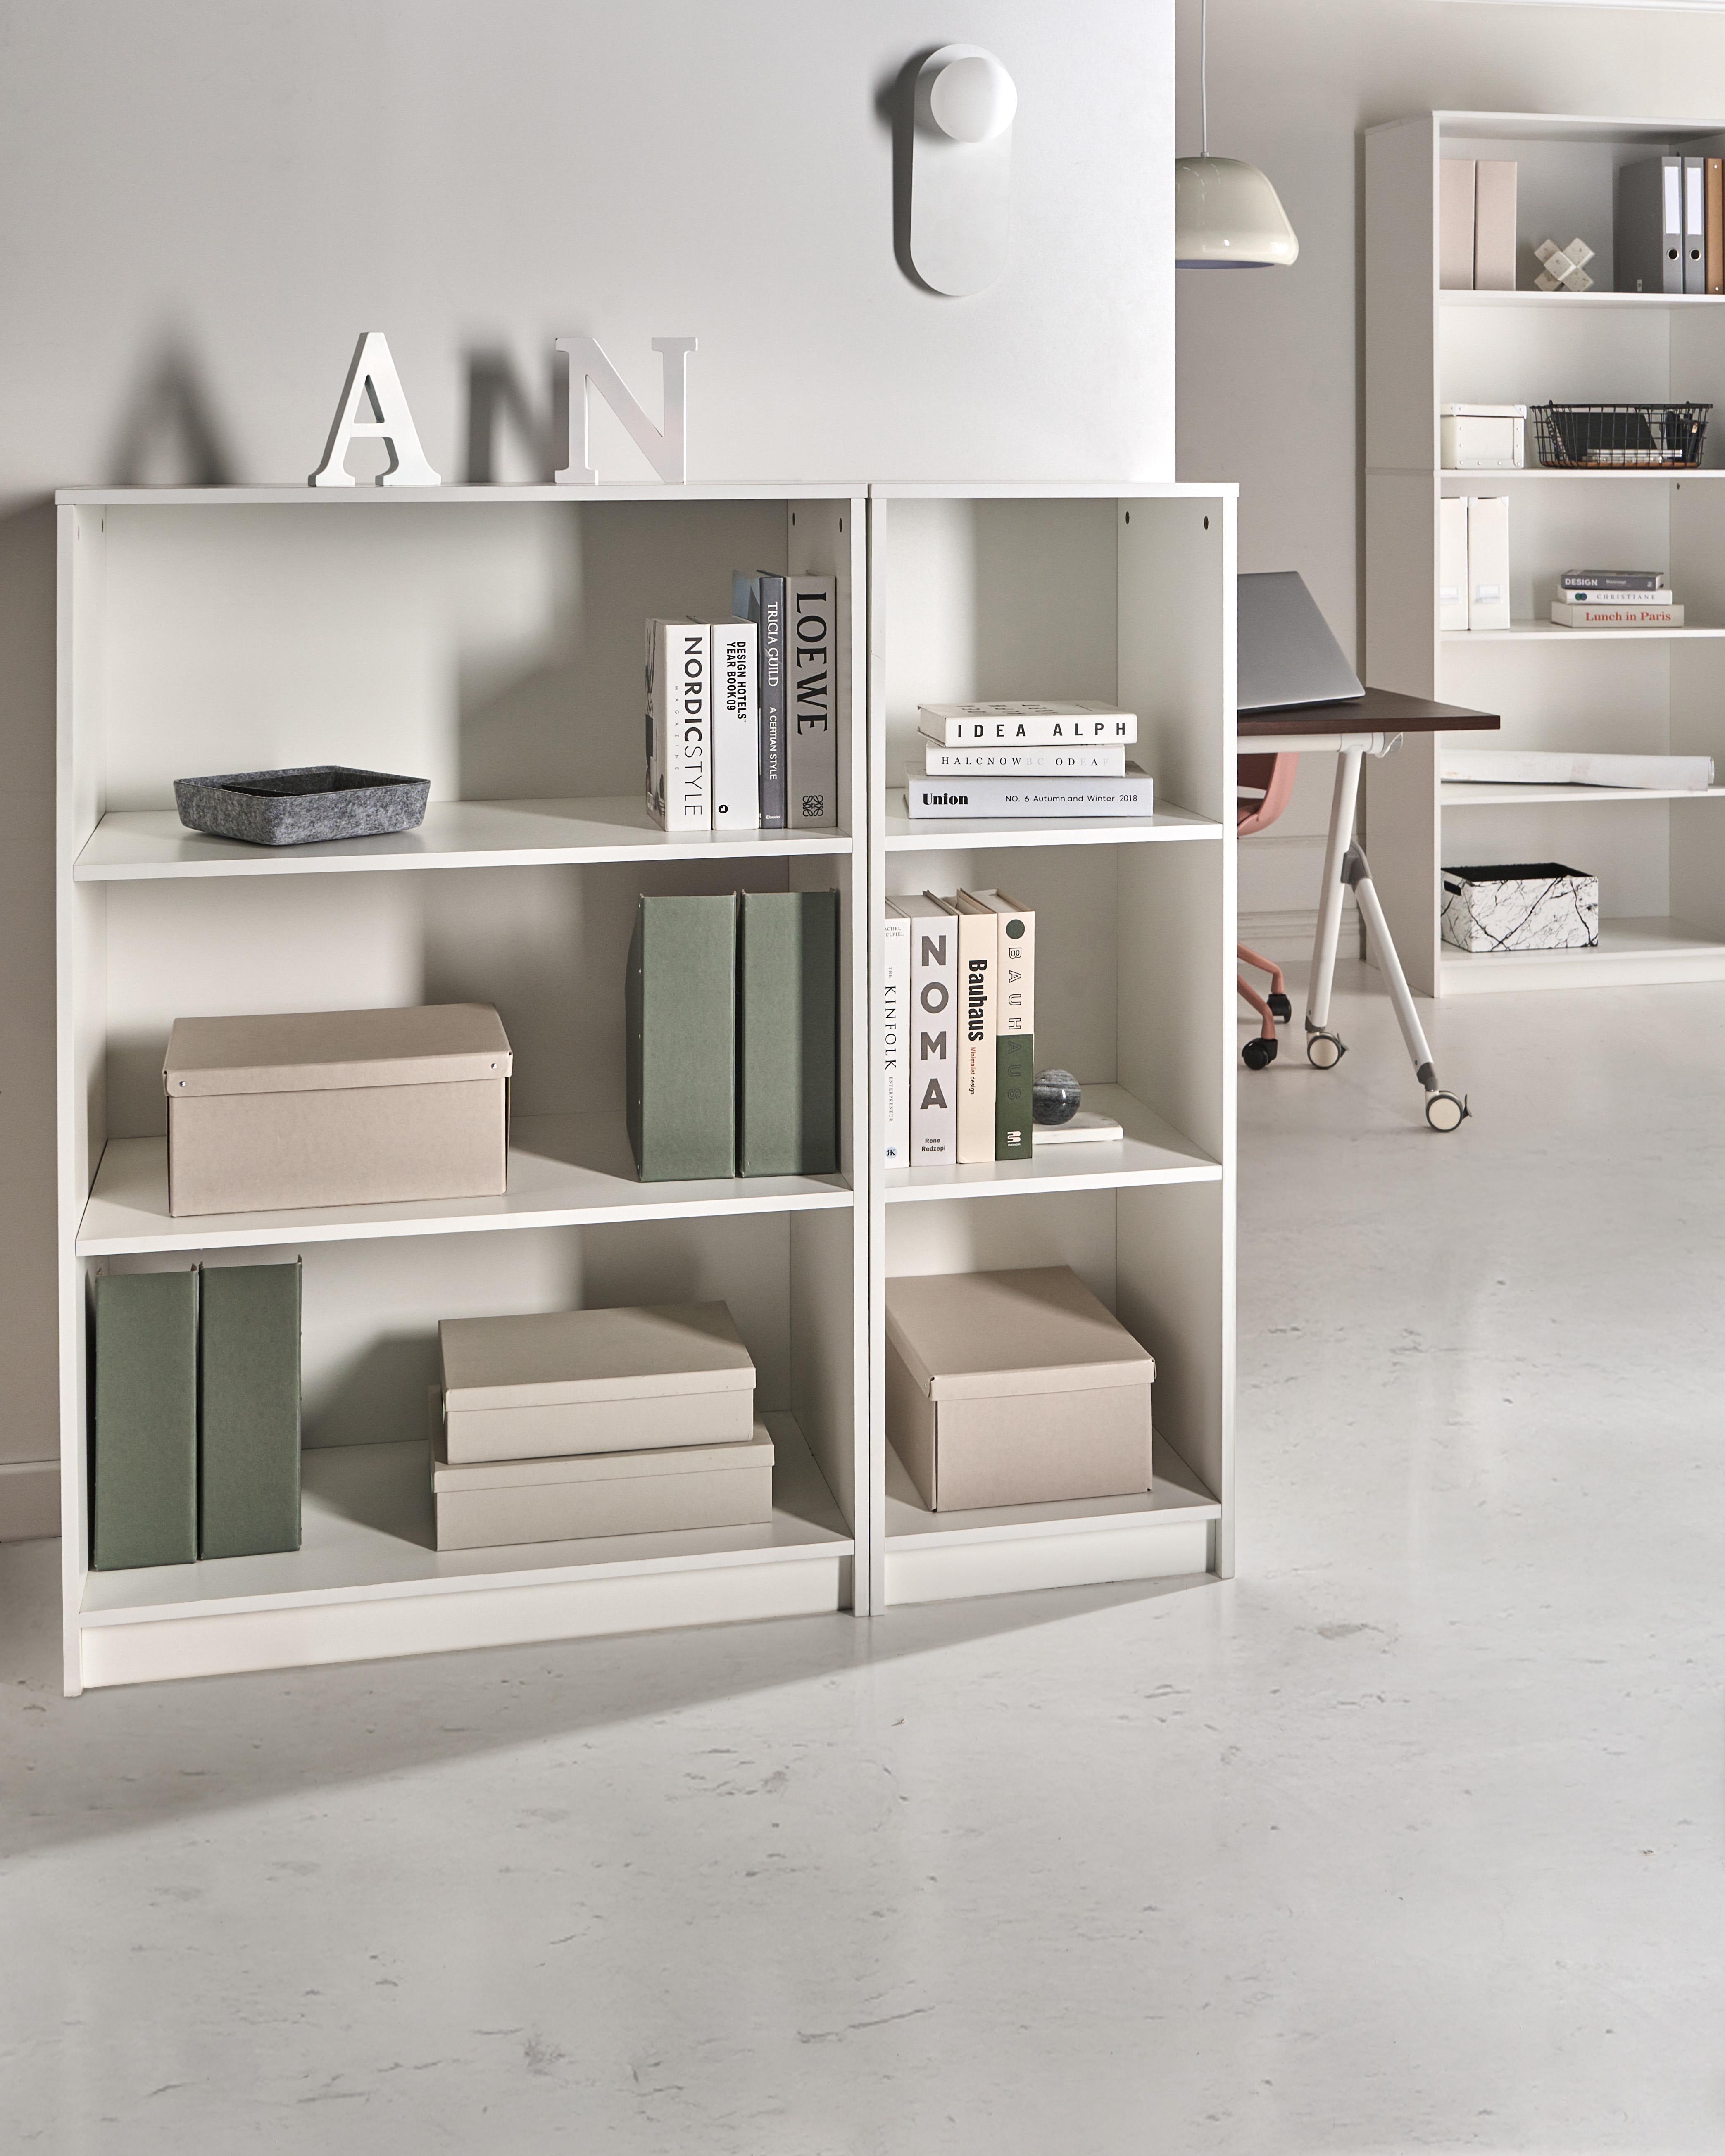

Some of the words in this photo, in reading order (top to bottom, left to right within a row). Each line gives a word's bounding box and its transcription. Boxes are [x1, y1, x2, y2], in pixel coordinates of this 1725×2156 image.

[307, 332, 442, 487] A
[554, 337, 698, 485] N
[767, 601, 778, 645] TRICIA
[1586, 612, 1622, 621] Lunch
[1626, 612, 1637, 621] in
[1641, 612, 1671, 621] Paris
[727, 642, 736, 667] YEAR
[737, 642, 746, 677] DESIGN
[768, 647, 778, 687] GUILD
[796, 592, 828, 736] LOEWE
[727, 671, 736, 711] BOOK09
[958, 724, 1026, 738] IDEA
[1053, 723, 1125, 736] ALPH
[923, 793, 968, 805] Union
[968, 960, 987, 1041] Bauhaus
[885, 985, 897, 1070] KINFOLK
[920, 935, 949, 1110] NOMA
[1008, 947, 1021, 1100] BAUHAUS
